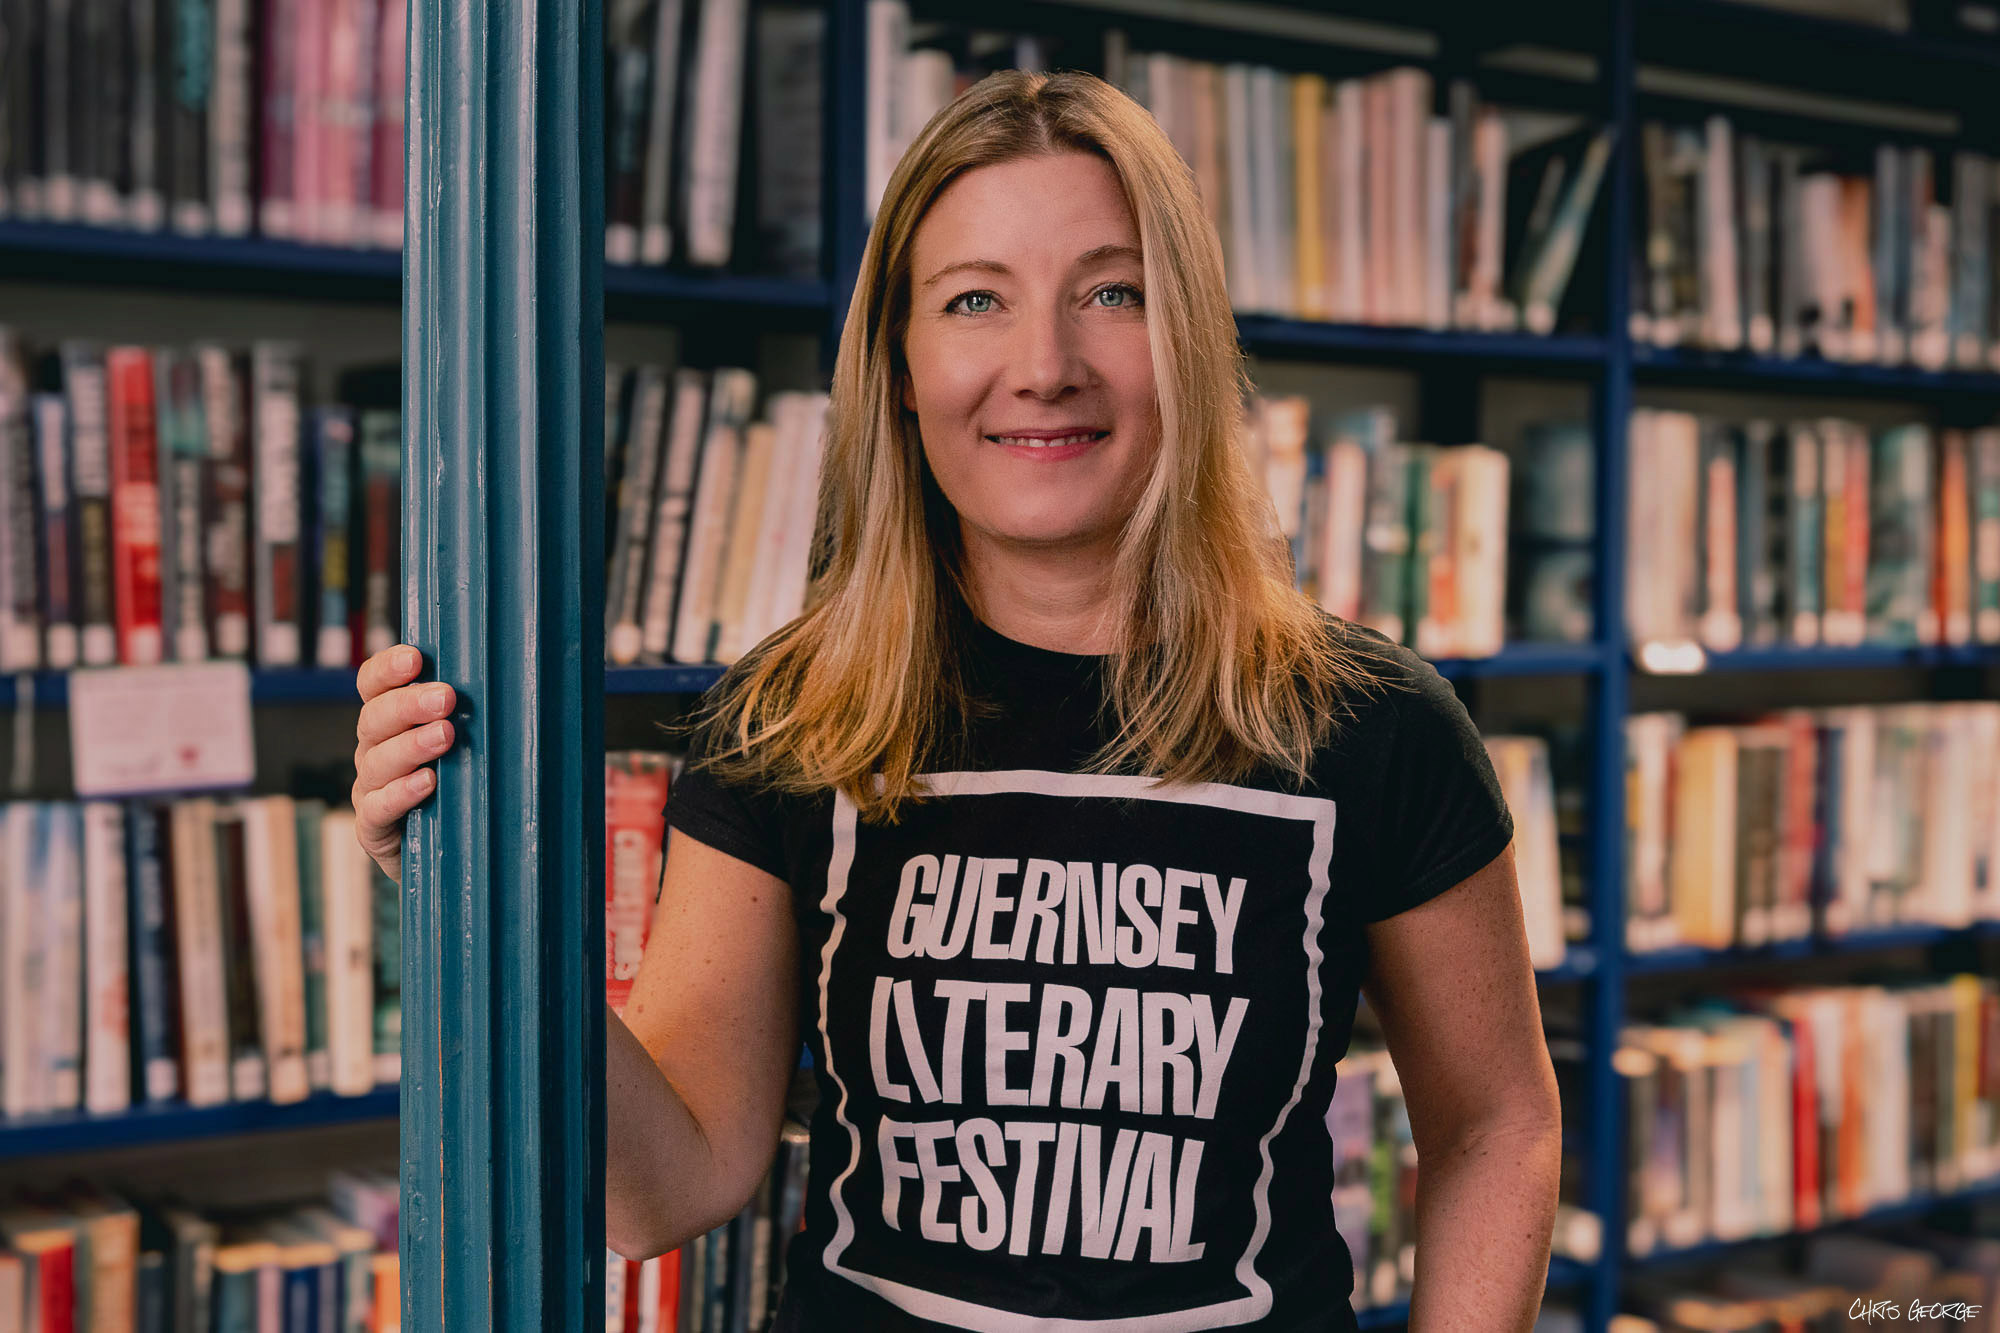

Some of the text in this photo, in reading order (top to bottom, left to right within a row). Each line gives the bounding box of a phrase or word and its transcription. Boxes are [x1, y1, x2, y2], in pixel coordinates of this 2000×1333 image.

[886, 853, 1248, 975] GUERNSEY
[869, 975, 1251, 1120] LITERARY
[877, 1113, 1207, 1264] FESTIVAL
